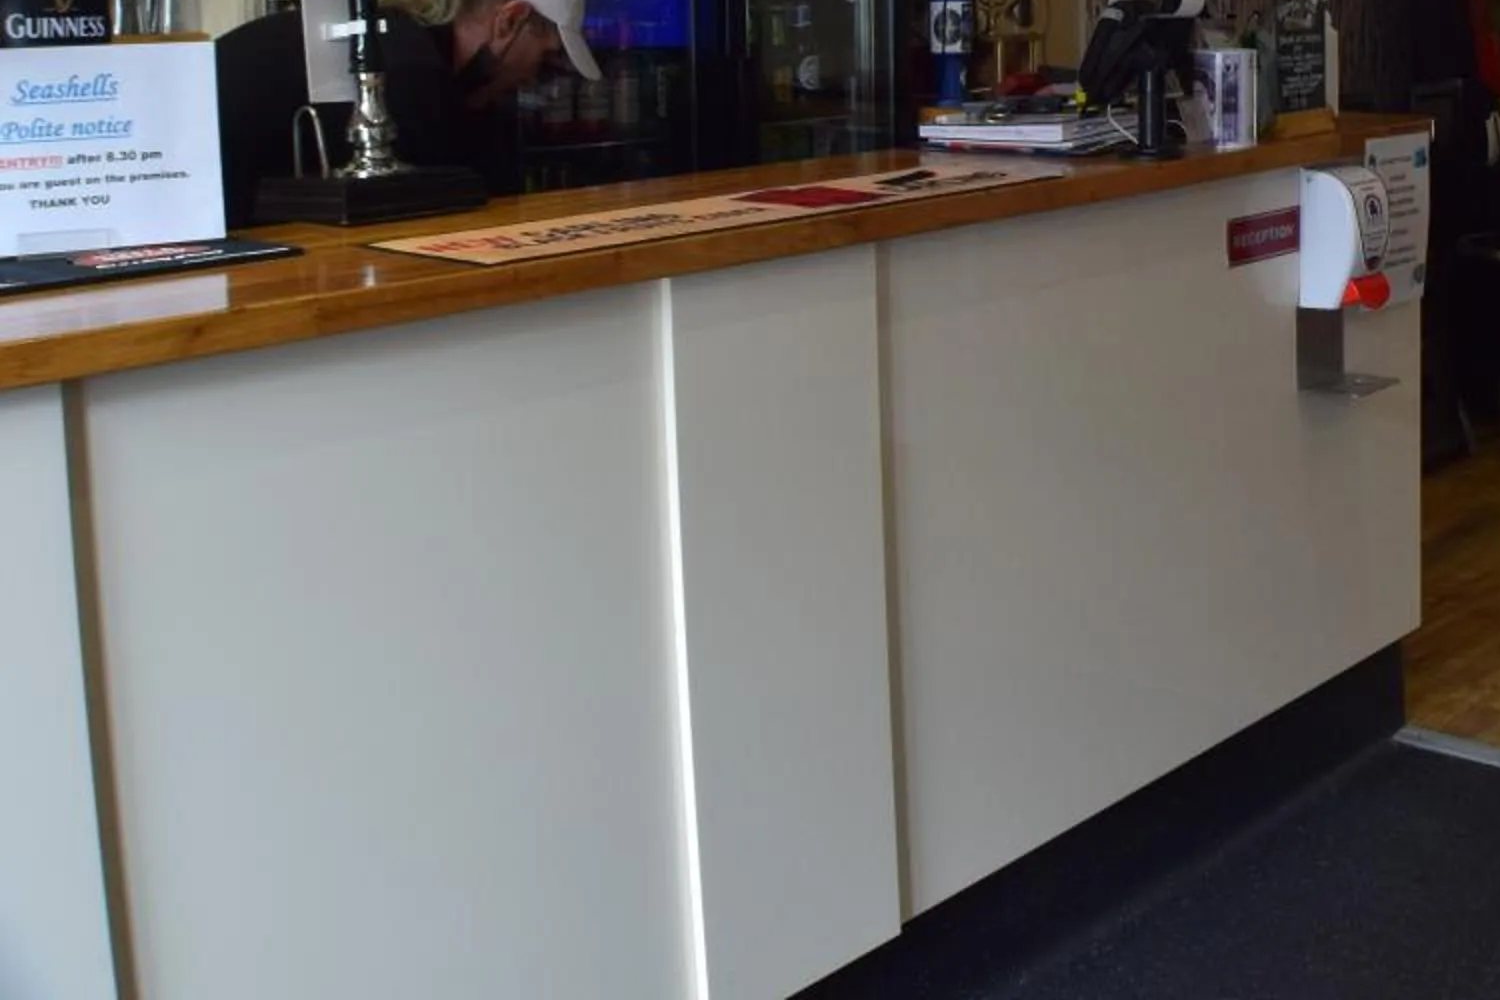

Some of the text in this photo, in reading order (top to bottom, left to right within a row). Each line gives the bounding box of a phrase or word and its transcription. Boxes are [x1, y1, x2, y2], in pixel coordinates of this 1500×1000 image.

[5, 13, 106, 39] GUINNESS
[11, 73, 119, 102] Seashells
[1, 116, 133, 140] Polite notice
[67, 152, 101, 165] after
[106, 150, 136, 162] 8.30
[141, 150, 162, 162] pm
[19, 180, 41, 190] are
[45, 177, 82, 190] guest
[85, 176, 102, 185] on
[105, 173, 126, 183] the
[129, 170, 191, 184] premises.
[30, 195, 111, 209] THANK YOU
[1233, 223, 1296, 246] RECEPTION
